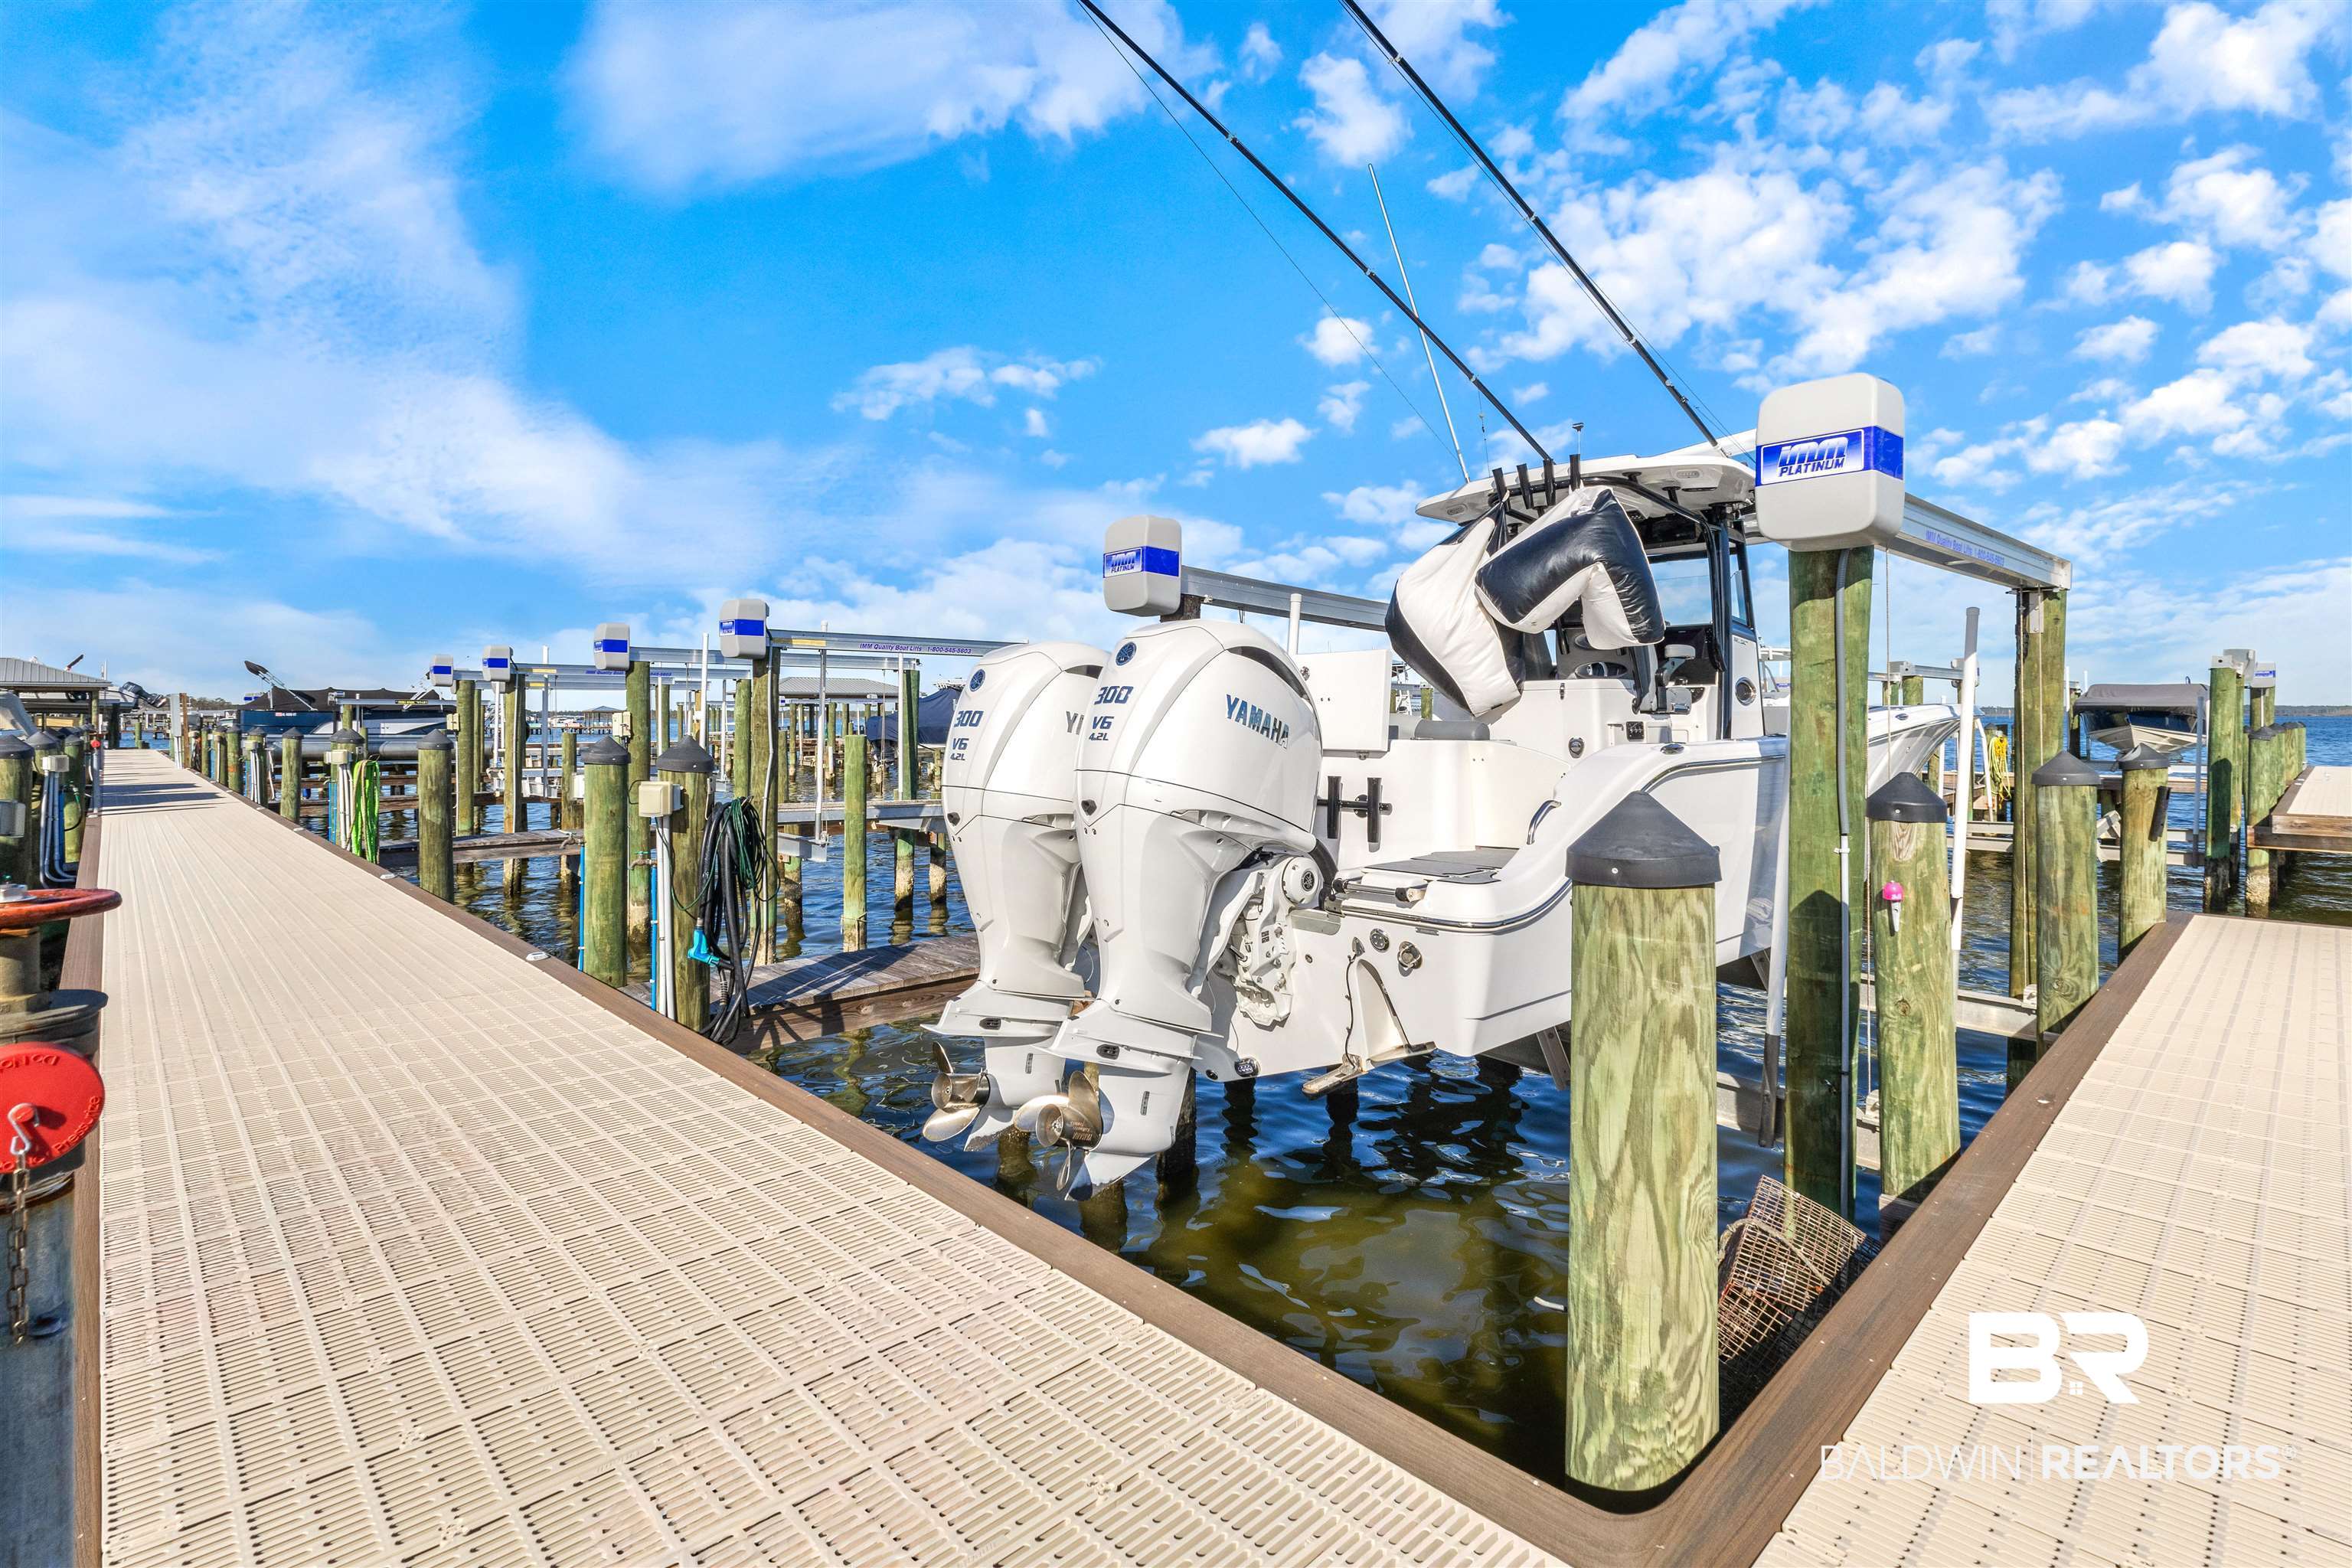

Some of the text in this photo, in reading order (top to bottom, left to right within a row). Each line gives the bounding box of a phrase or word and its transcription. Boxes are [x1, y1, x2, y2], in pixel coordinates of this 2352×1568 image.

[1779, 458, 1845, 477] PLATINUM
[1111, 563, 1135, 573] PLATINUM
[926, 646, 972, 655] 1-800-545-5603
[1094, 685, 1134, 705] 300
[954, 710, 985, 727] 300
[1092, 716, 1115, 730] V6
[1226, 694, 1290, 750] YAMAHA
[952, 737, 969, 750] V6
[1089, 732, 1109, 741] 4.2L
[949, 753, 965, 761] 4.2L
[52, 1096, 101, 1153] Pressurize
